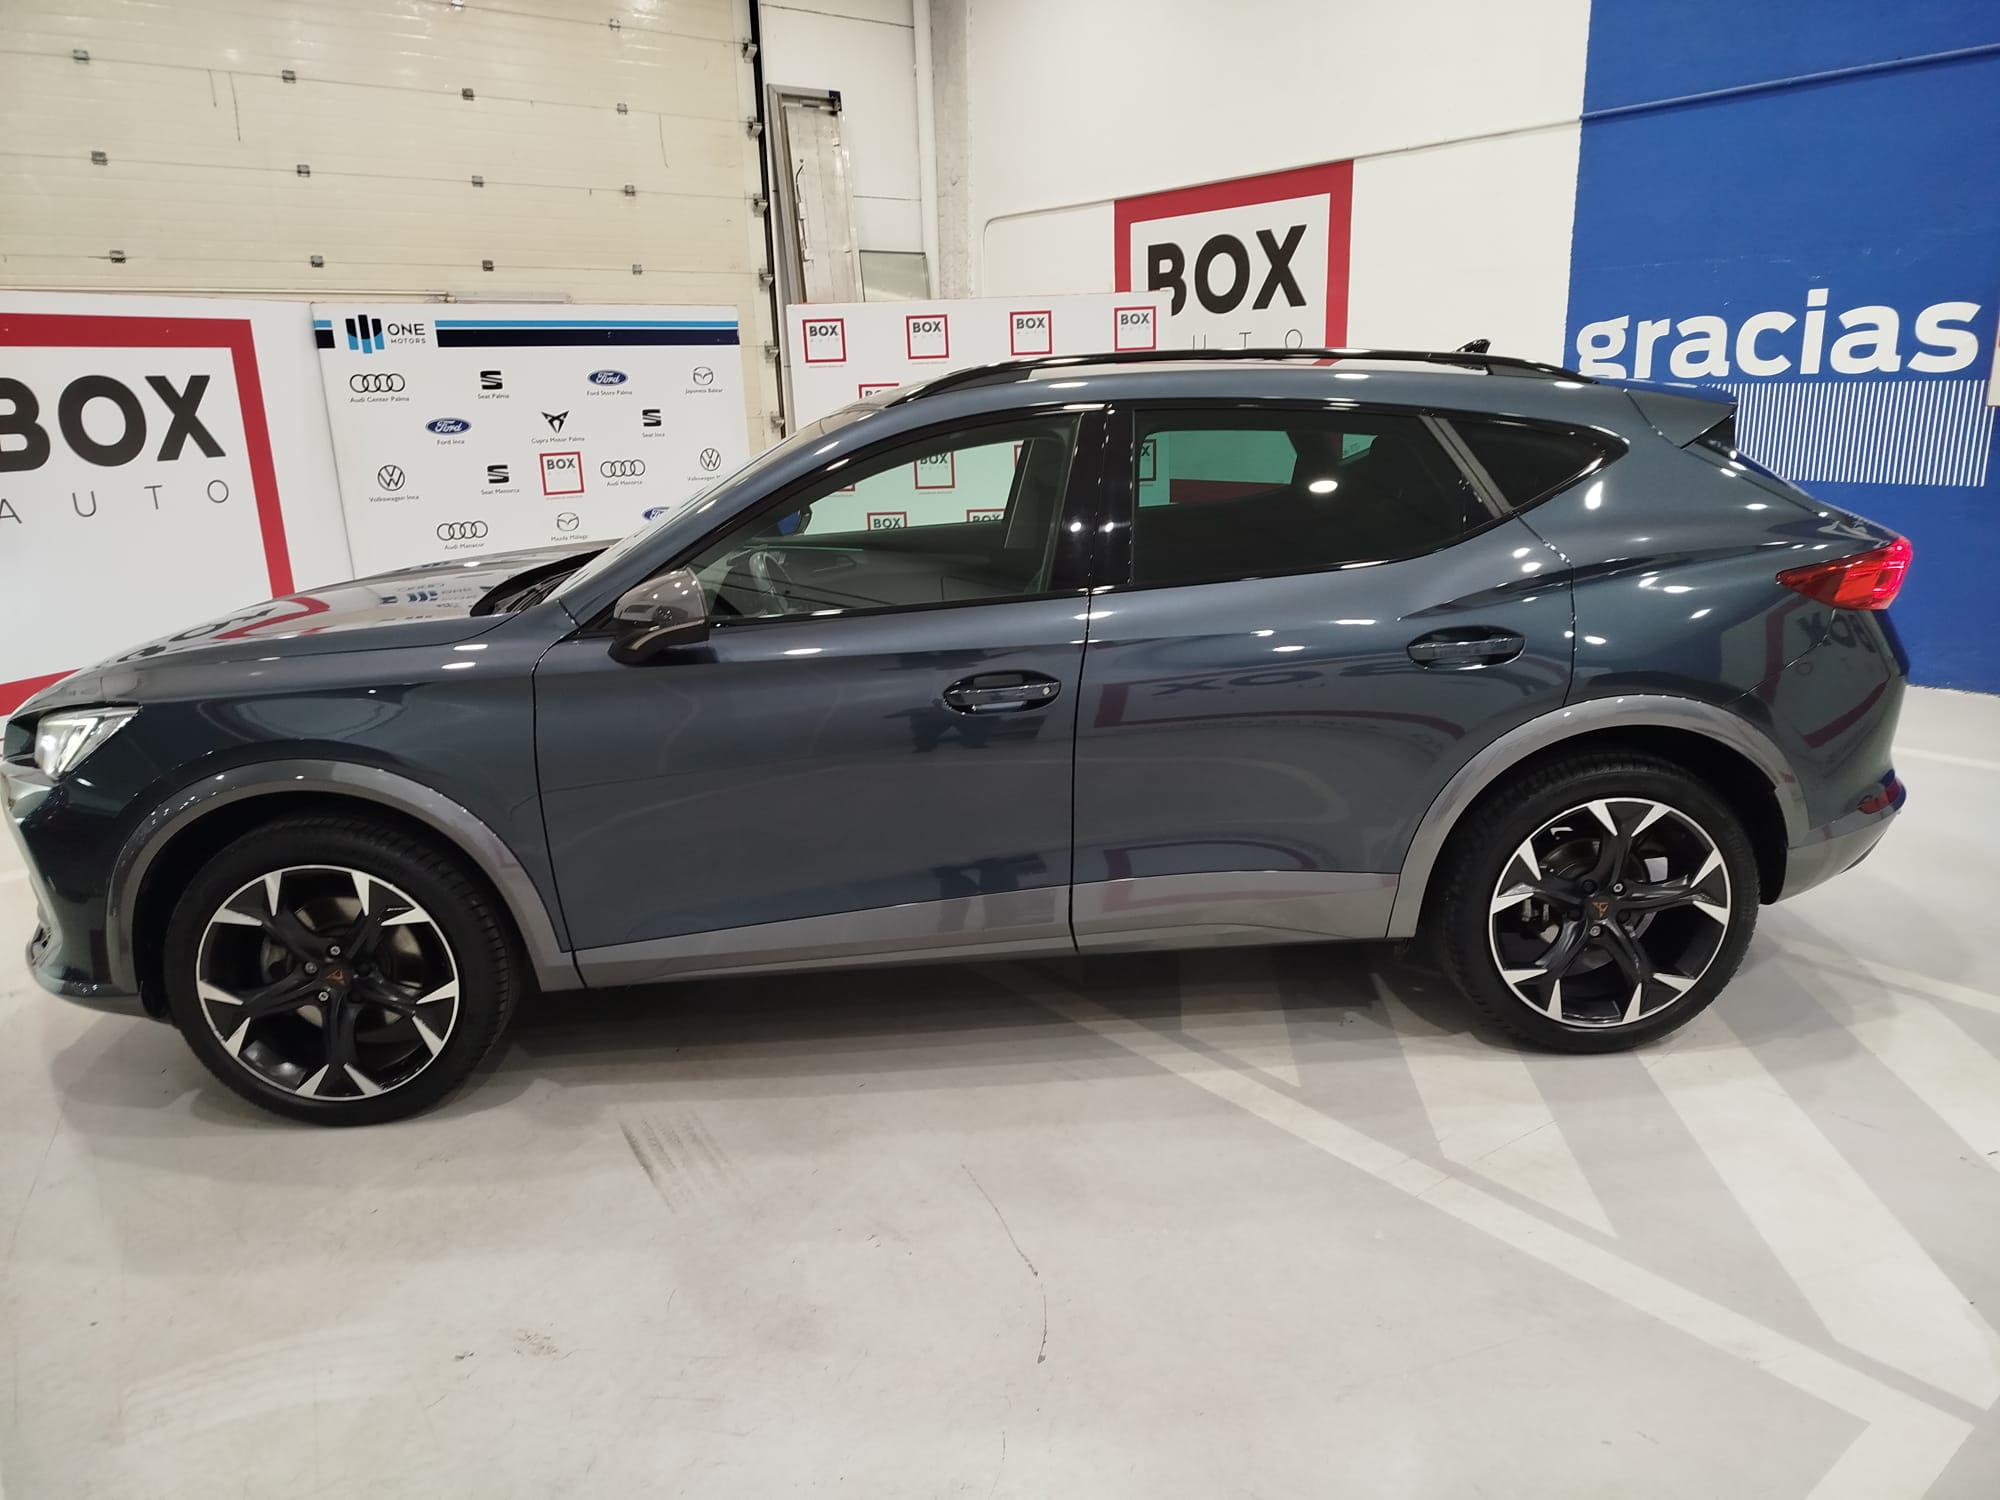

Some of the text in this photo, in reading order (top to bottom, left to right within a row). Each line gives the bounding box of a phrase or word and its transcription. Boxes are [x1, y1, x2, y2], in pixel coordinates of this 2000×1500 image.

[1148, 224, 1307, 316] BOX
[1016, 317, 1046, 329] BOX
[1120, 312, 1151, 325] BOX
[387, 323, 426, 336] ONE
[809, 325, 838, 337] BOX
[912, 321, 942, 333] BOX
[1576, 288, 1982, 379] gracias
[1193, 328, 1303, 350] UTO
[596, 372, 620, 384] Ford
[0, 374, 227, 473] BOX
[434, 420, 463, 433] Ford
[546, 458, 576, 470] BOX
[0, 480, 230, 524] AUTO
[873, 517, 902, 529] BOX
